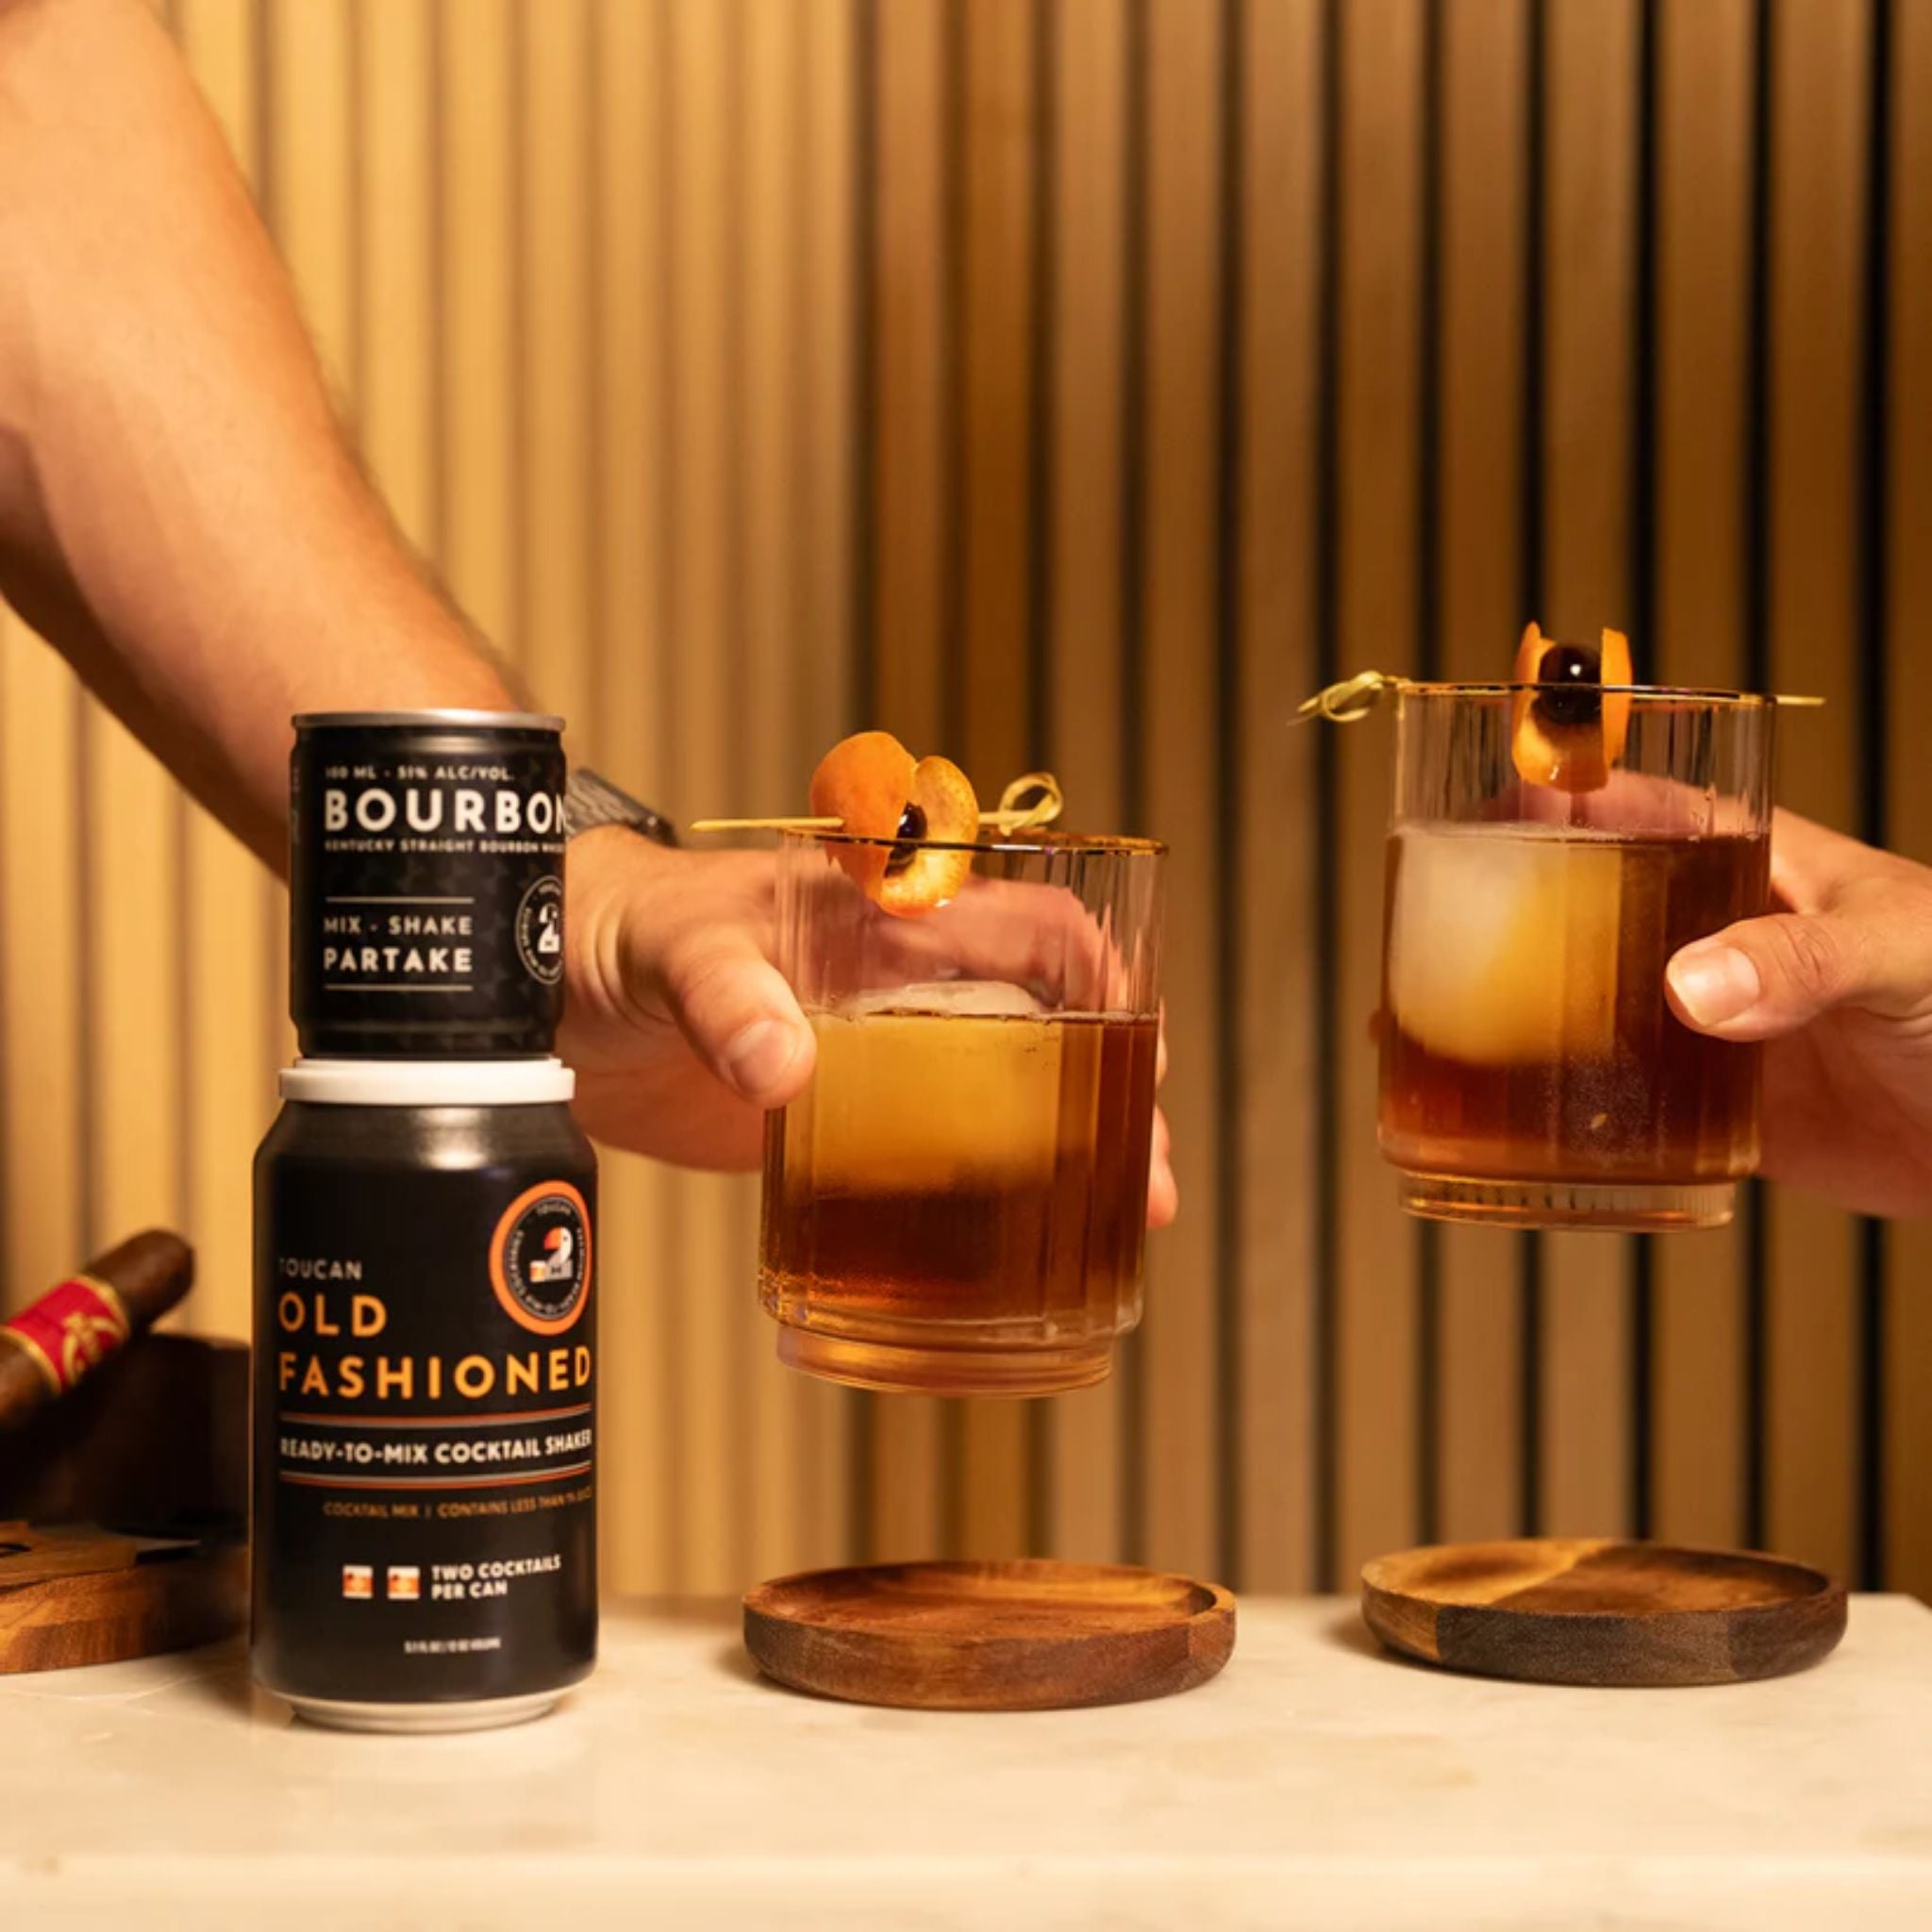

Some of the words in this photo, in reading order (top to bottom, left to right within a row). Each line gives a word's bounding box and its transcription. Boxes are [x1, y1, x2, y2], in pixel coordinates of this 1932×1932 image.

[353, 765, 376, 780] ML
[397, 765, 428, 780] 51%
[400, 839, 473, 854] STRAIGHT
[478, 840, 539, 854] BOURBON
[324, 917, 361, 935] MIX
[388, 916, 473, 936] SHAKE
[324, 947, 474, 973] PARTAKE
[278, 1291, 387, 1338] OLD
[279, 1346, 591, 1400] FASHIONED
[281, 1438, 428, 1464] READY-TO-MIX
[434, 1438, 541, 1464] COCKTAIL
[431, 1563, 475, 1581] TWO
[477, 1554, 561, 1579] COCKTAILS
[431, 1584, 465, 1600] PER
[469, 1579, 508, 1599] CAN
